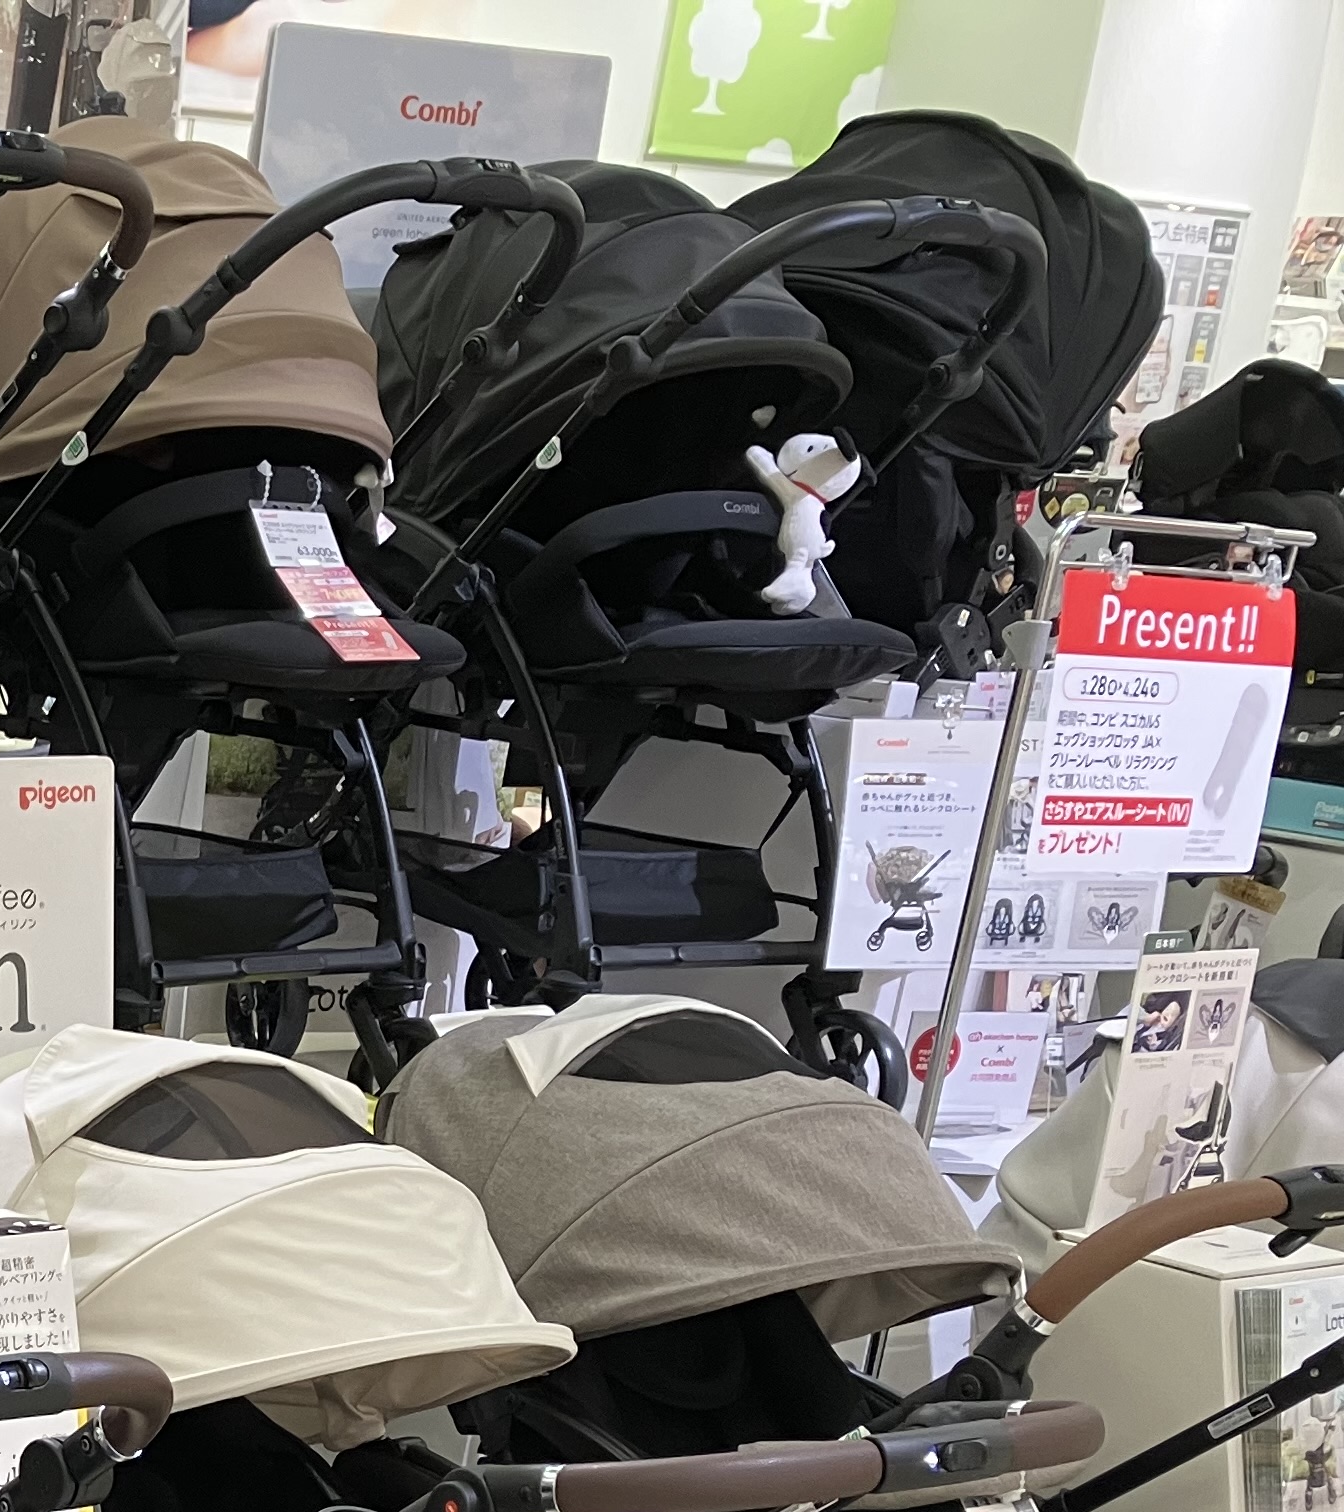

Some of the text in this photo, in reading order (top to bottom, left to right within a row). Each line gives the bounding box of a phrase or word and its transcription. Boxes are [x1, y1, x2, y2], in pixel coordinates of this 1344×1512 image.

[400, 94, 483, 128] Combi
[723, 501, 760, 515] Combi
[1097, 595, 1260, 654] Present!!
[18, 779, 96, 811] pigeon
